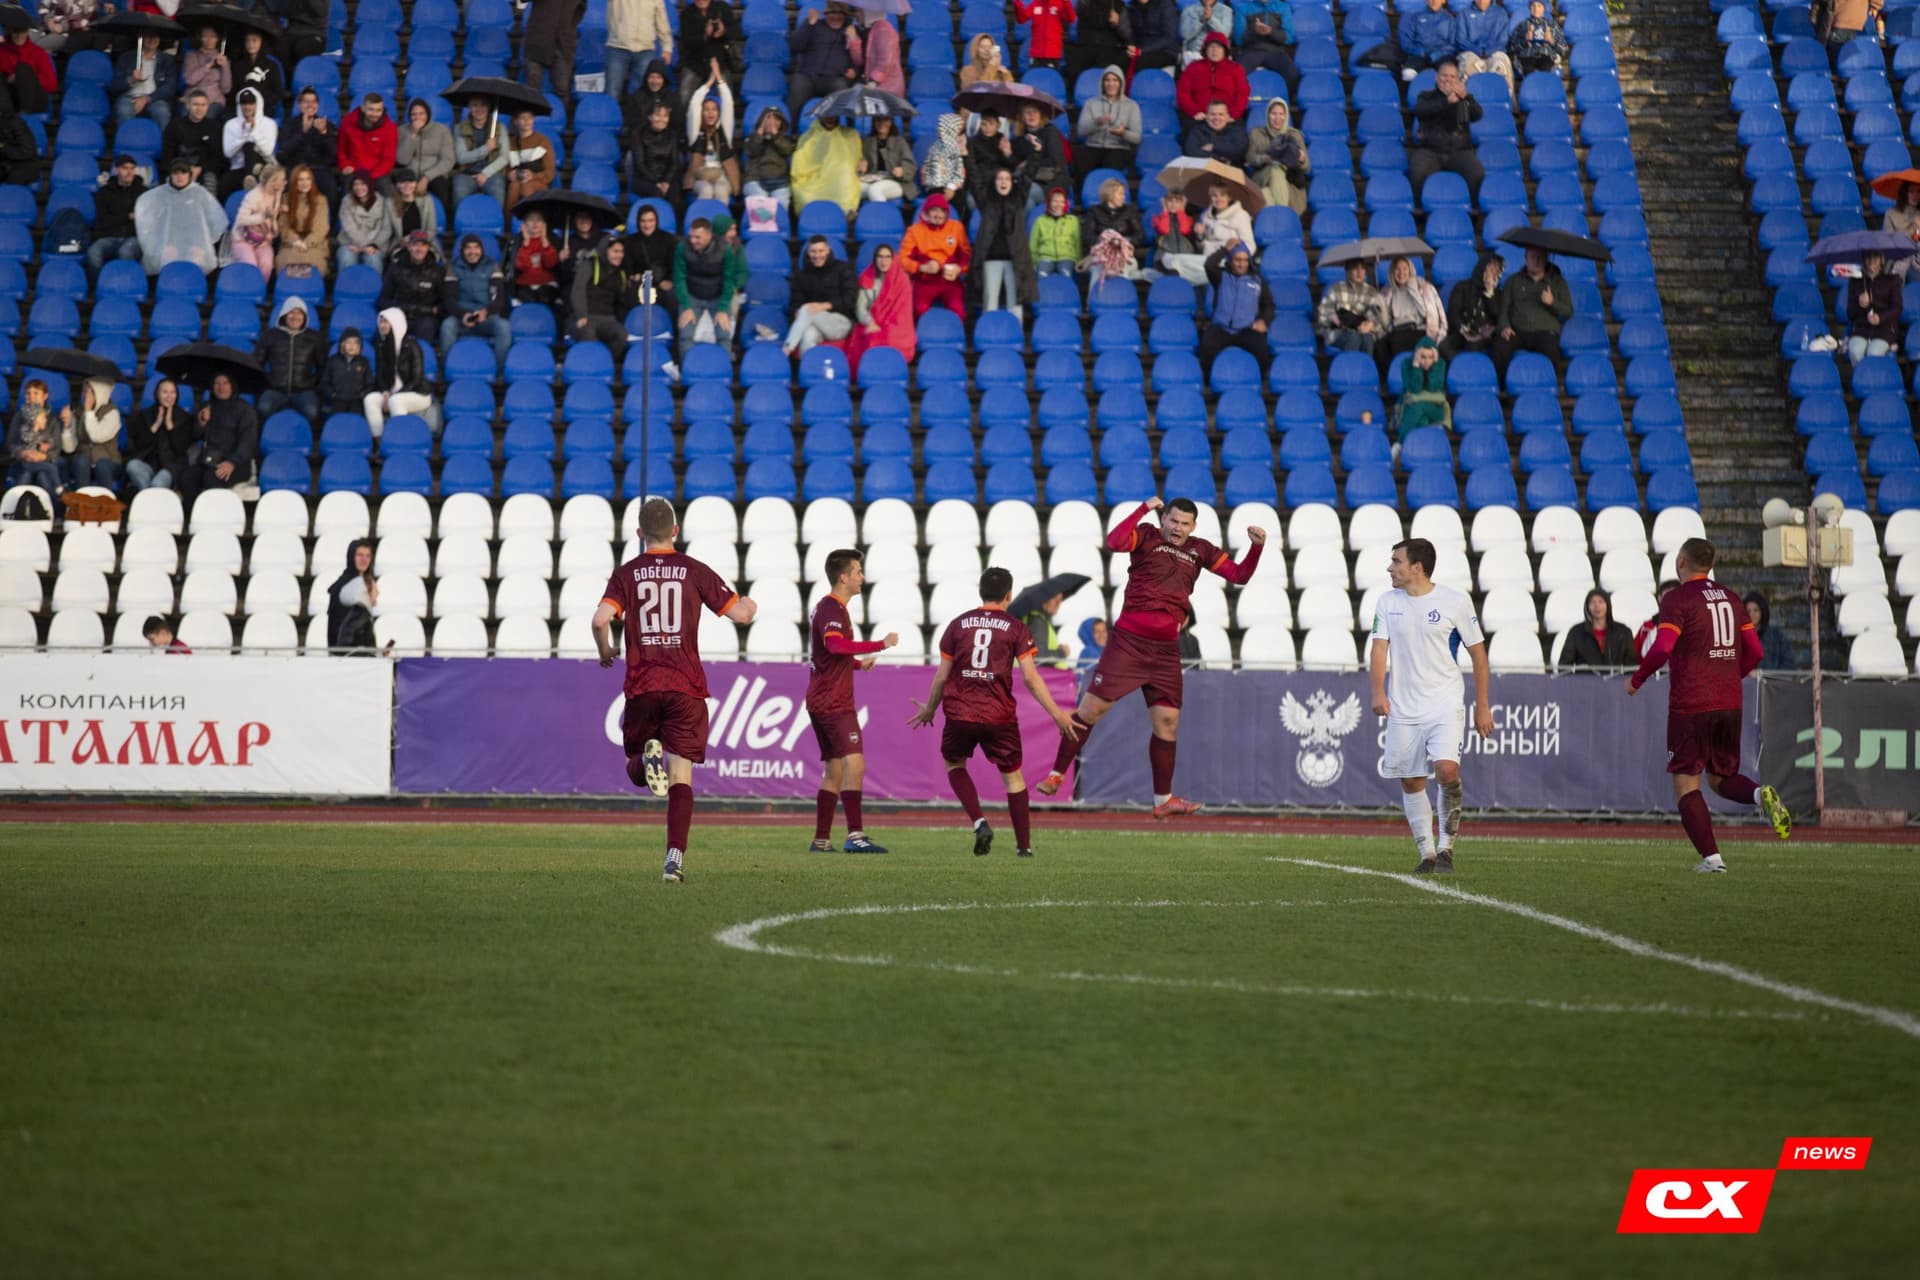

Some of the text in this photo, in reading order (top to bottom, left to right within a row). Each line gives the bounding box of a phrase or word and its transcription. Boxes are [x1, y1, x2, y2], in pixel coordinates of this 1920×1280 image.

[633, 566, 687, 581] БОБЕШКО
[637, 581, 683, 633] 20
[1706, 602, 1735, 647] 10
[641, 635, 682, 645] SEUS
[971, 629, 992, 669] 8
[1709, 649, 1736, 658] SEUS
[20, 694, 186, 710] КОМПАНИЯ
[718, 759, 804, 778] МЕДИА1
